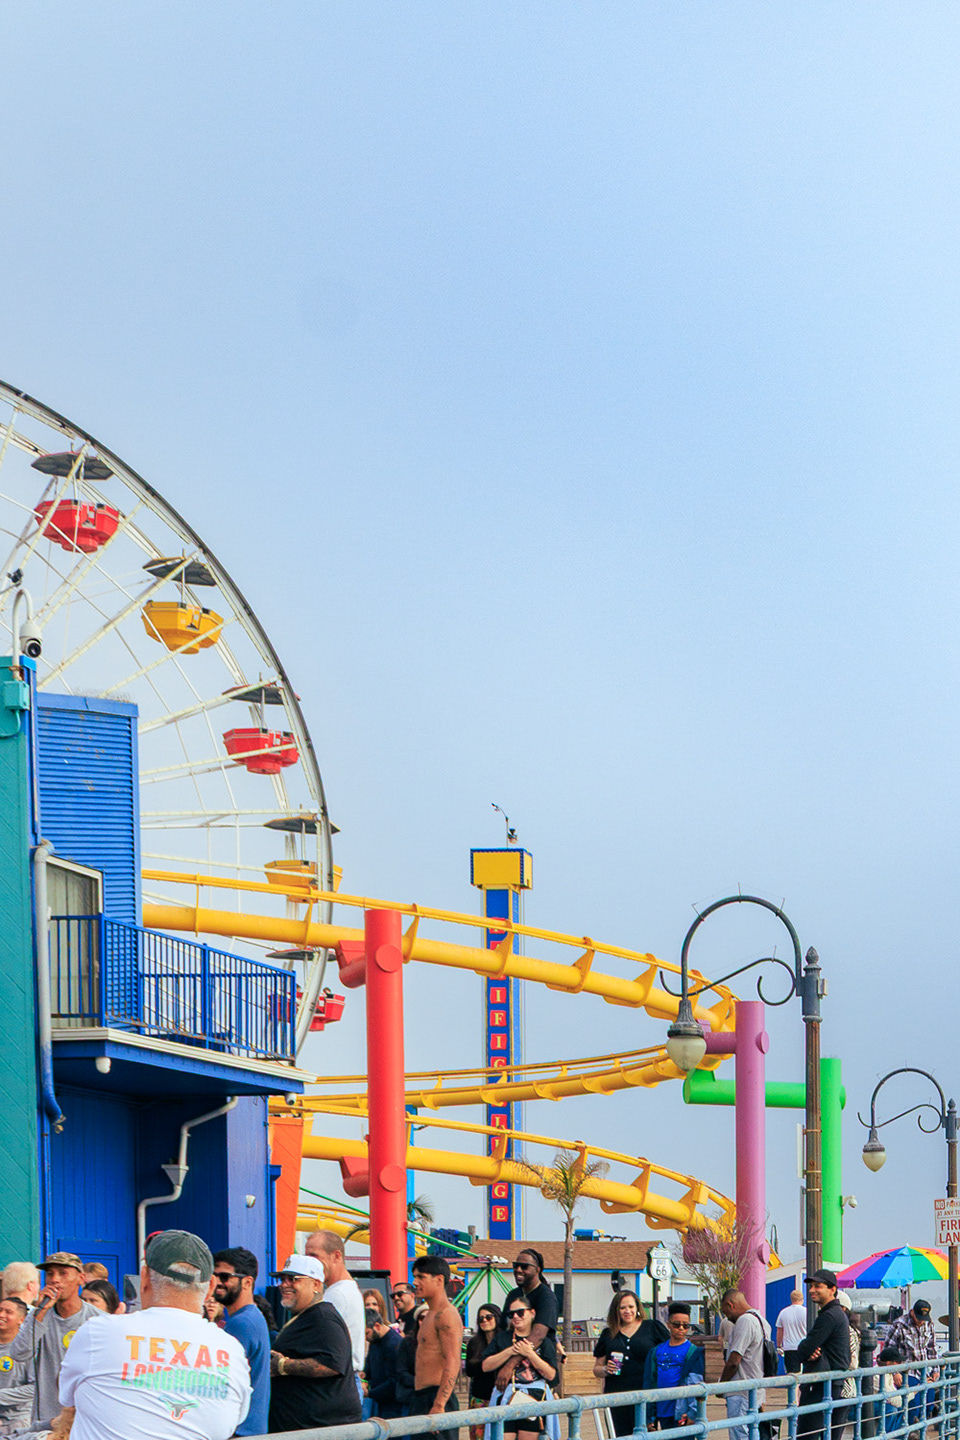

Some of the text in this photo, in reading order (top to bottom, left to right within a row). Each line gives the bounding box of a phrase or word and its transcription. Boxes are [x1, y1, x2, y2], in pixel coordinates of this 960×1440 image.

[935, 1200, 944, 1209] NO
[656, 1265, 667, 1276] 66
[125, 1335, 230, 1374] TEXAS
[120, 1362, 229, 1400] LONGHORNS
